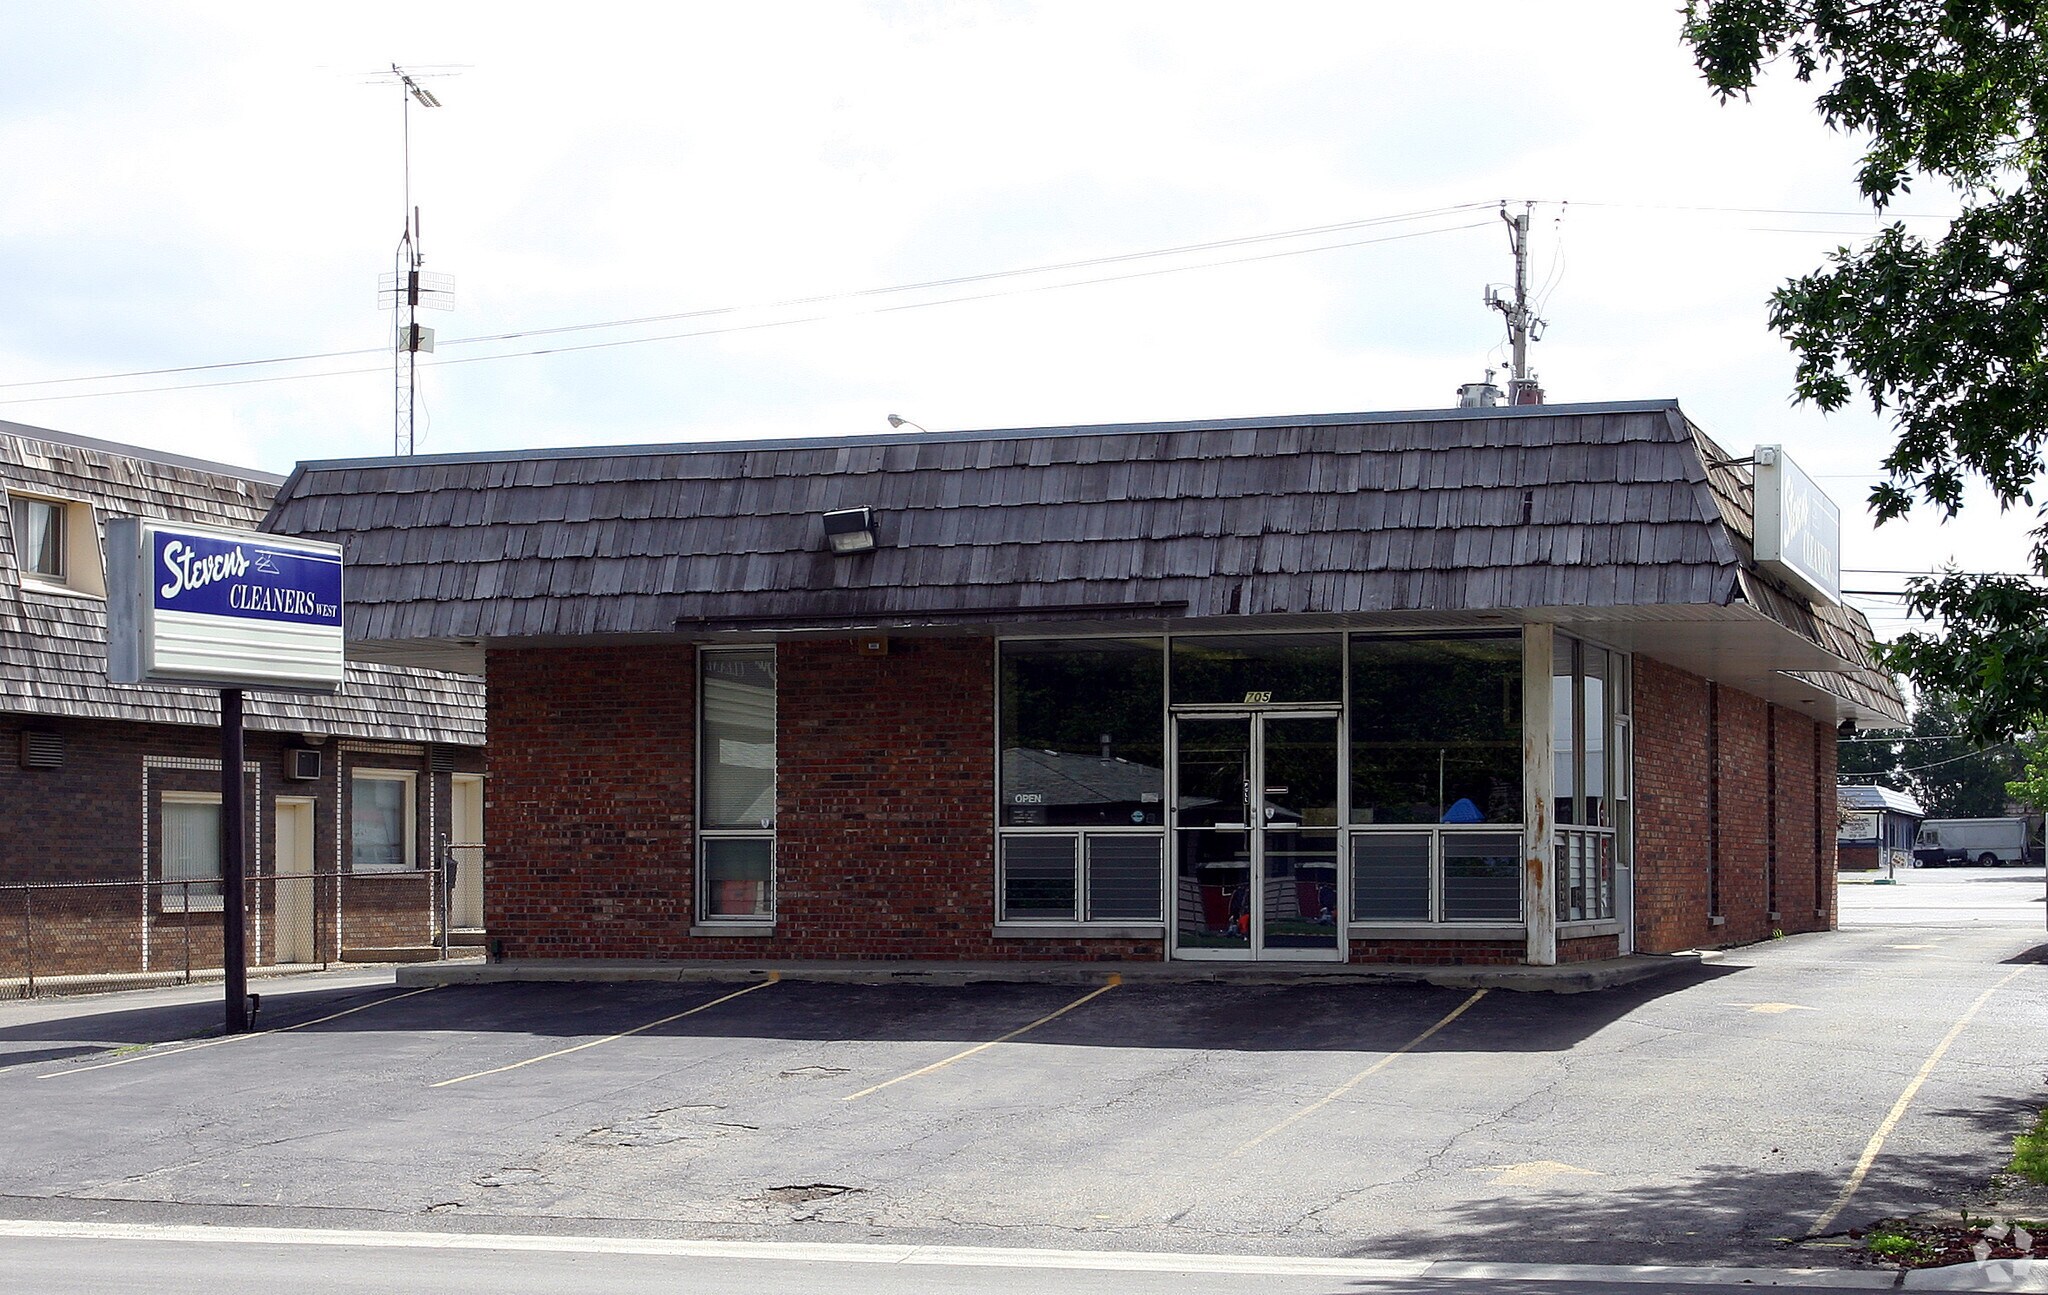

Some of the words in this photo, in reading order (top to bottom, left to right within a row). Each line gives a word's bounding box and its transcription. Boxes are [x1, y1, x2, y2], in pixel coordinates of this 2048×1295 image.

[161, 540, 250, 599] Stevens
[229, 583, 316, 616] CLEANERS
[316, 604, 338, 618] WEST
[1246, 692, 1270, 703] 705
[1014, 793, 1042, 803] OPEN
